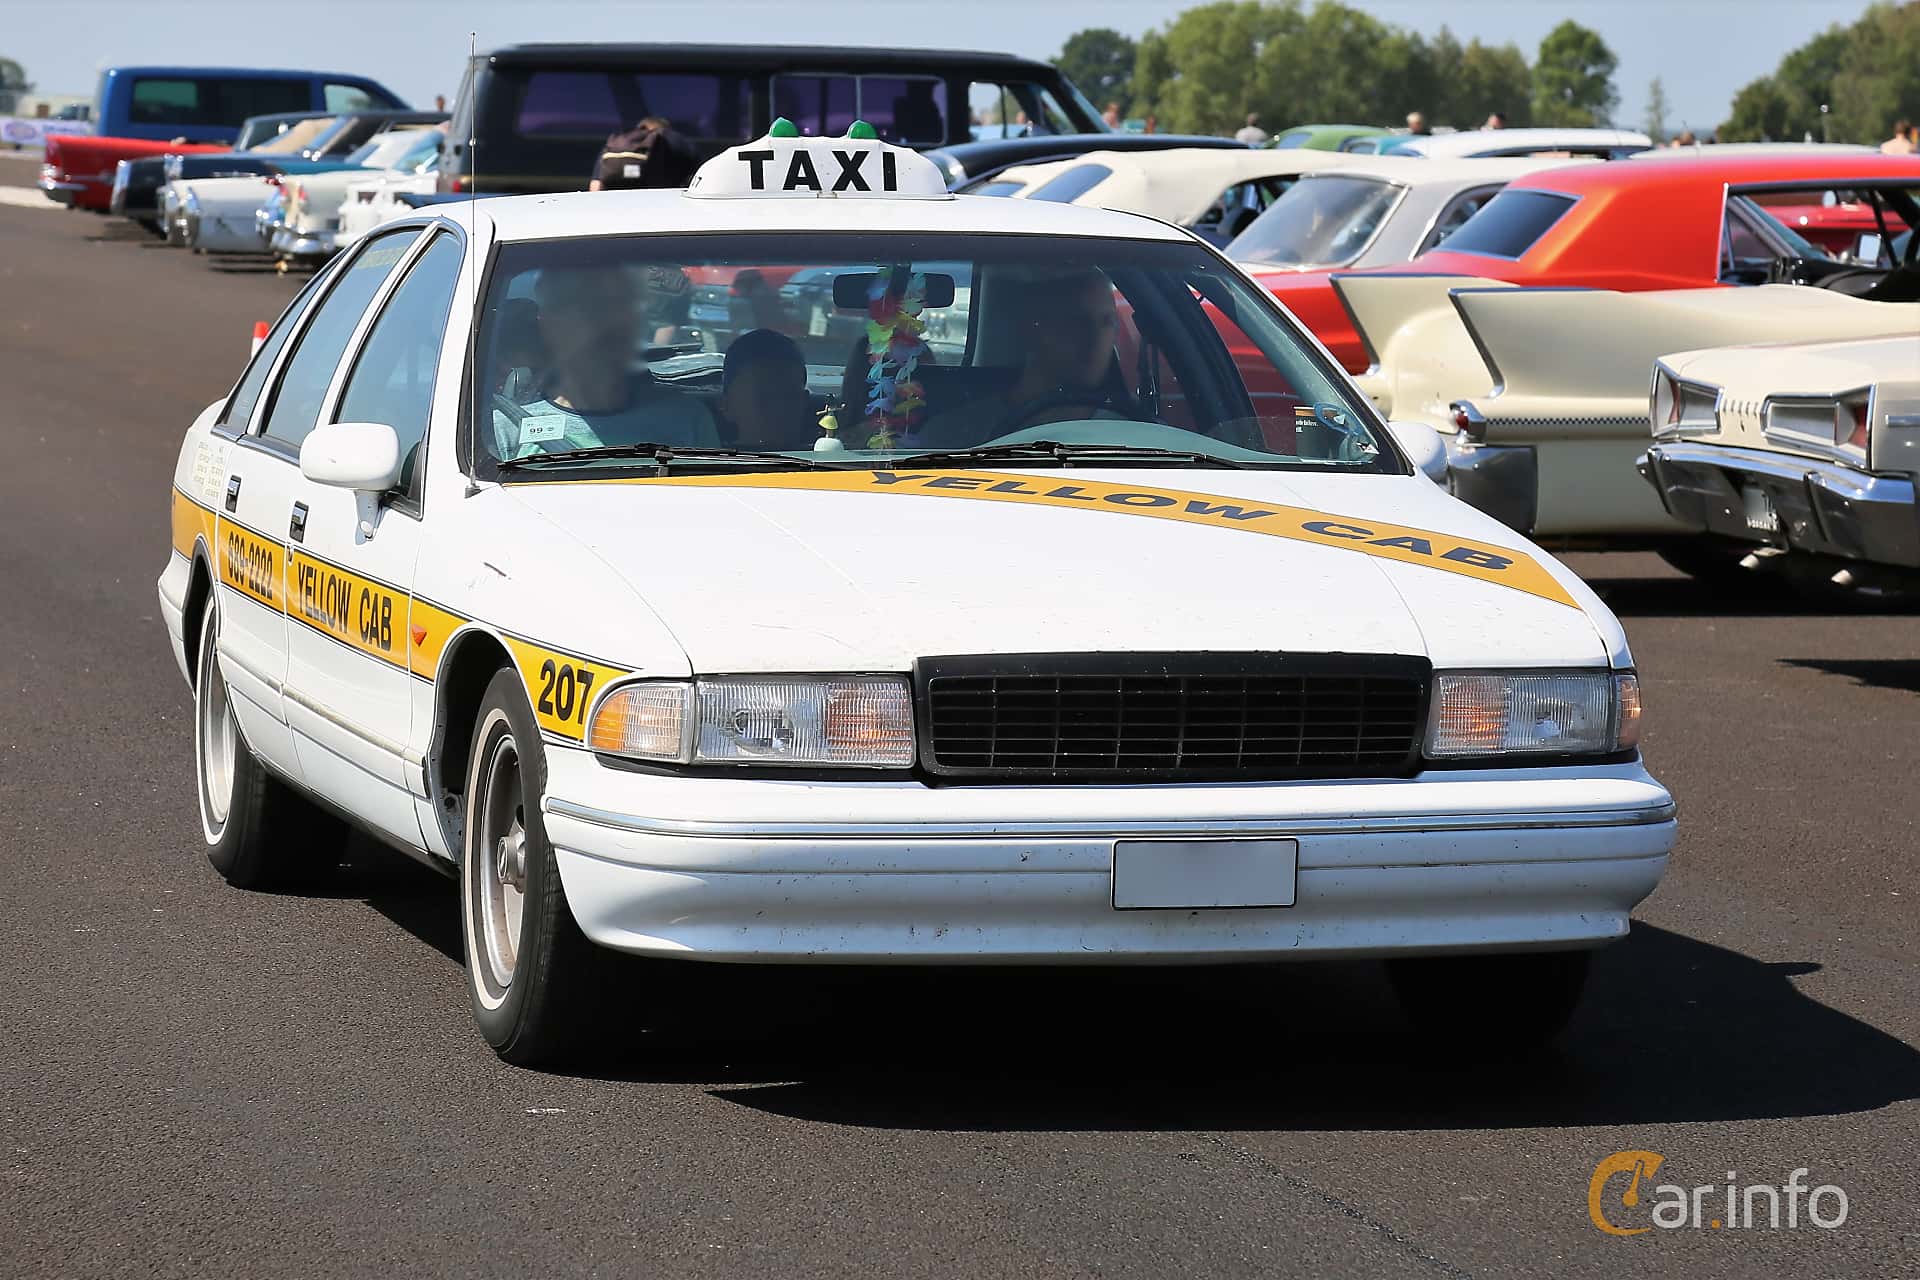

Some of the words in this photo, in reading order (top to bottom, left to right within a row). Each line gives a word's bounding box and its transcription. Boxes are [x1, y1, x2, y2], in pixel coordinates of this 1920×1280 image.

[738, 150, 898, 191] TAXI
[869, 471, 1277, 520] YELLOW
[1301, 520, 1514, 571] CAB
[228, 531, 272, 600] 689-2222
[298, 562, 351, 633] YELLOW
[359, 587, 392, 651] CAB
[538, 659, 595, 725] 207
